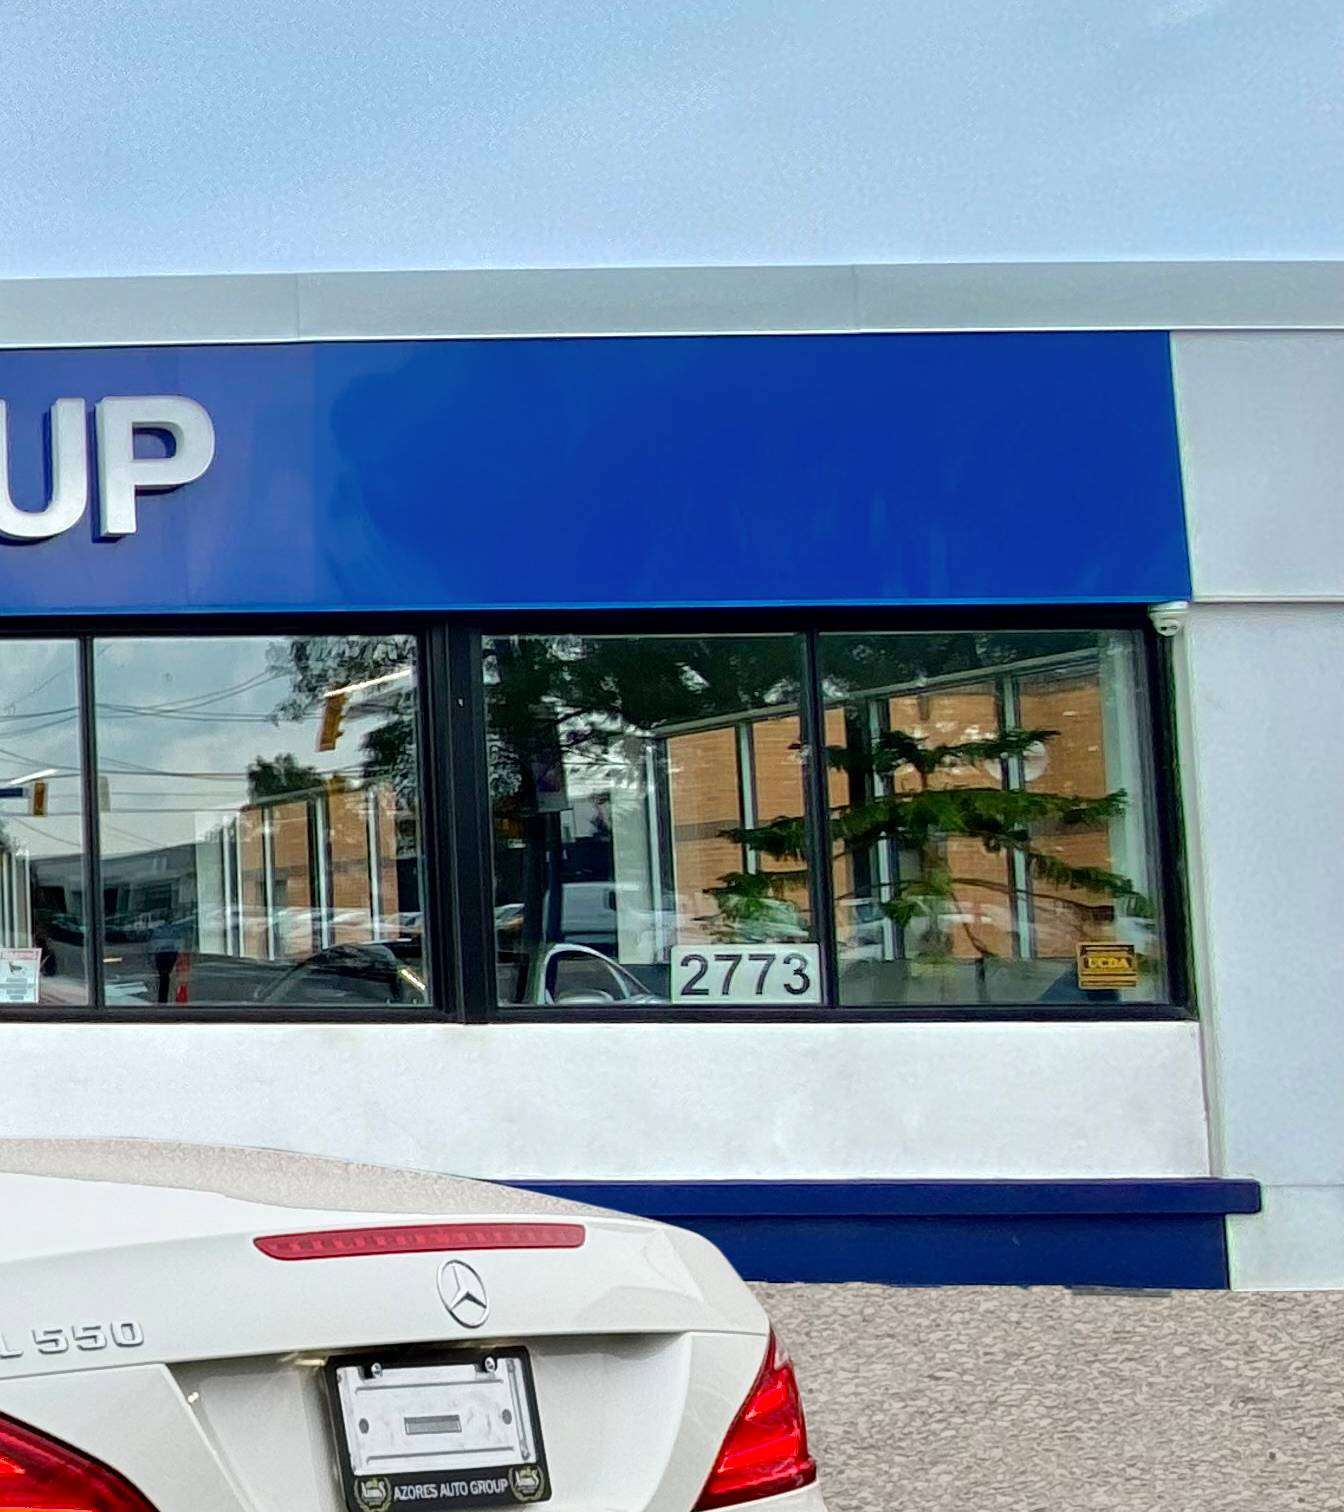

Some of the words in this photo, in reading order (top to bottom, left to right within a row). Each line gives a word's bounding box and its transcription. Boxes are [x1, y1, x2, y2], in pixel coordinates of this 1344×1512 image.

[680, 953, 810, 996] 2773
[32, 1320, 145, 1355] 550
[394, 1484, 438, 1501] AZORES
[440, 1482, 469, 1498] AUTO
[470, 1478, 509, 1496] GROUP
